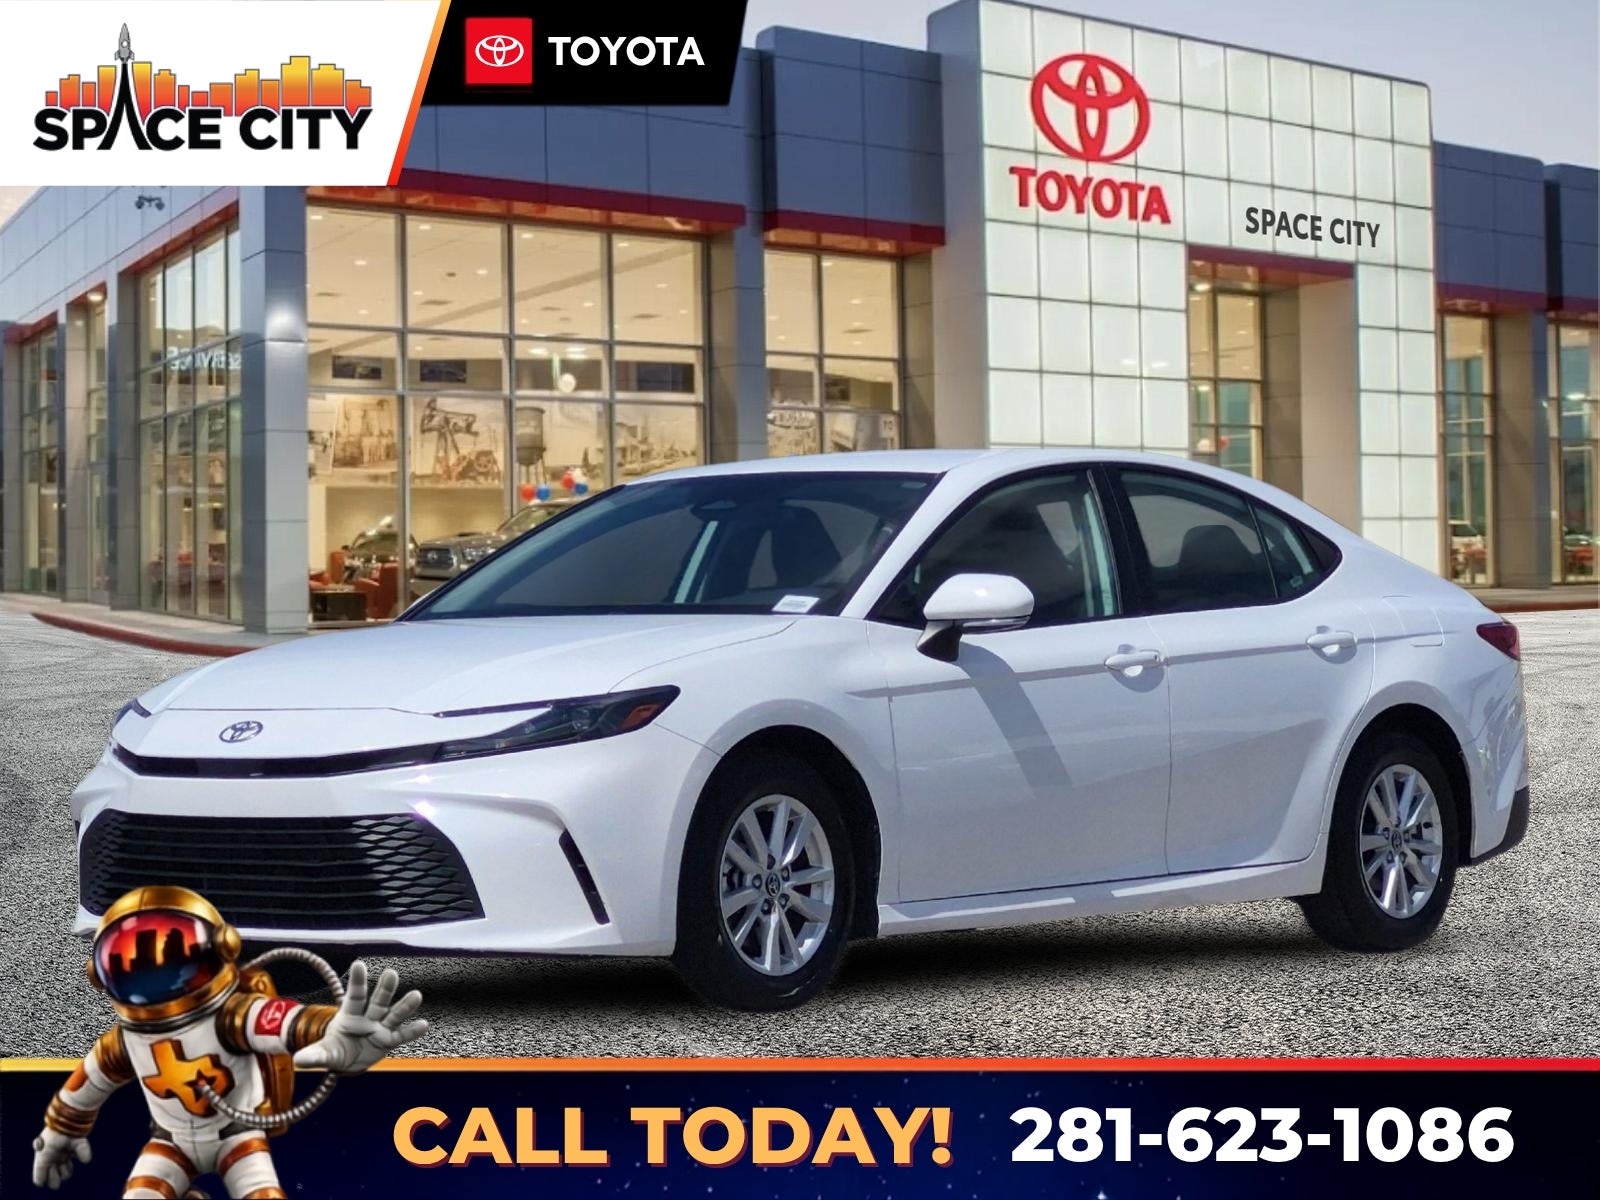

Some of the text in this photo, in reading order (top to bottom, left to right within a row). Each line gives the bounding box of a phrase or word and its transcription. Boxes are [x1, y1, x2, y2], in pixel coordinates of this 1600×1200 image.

[1009, 166, 1171, 225] TOYOTA
[1245, 206, 1381, 249] SPACE CITY
